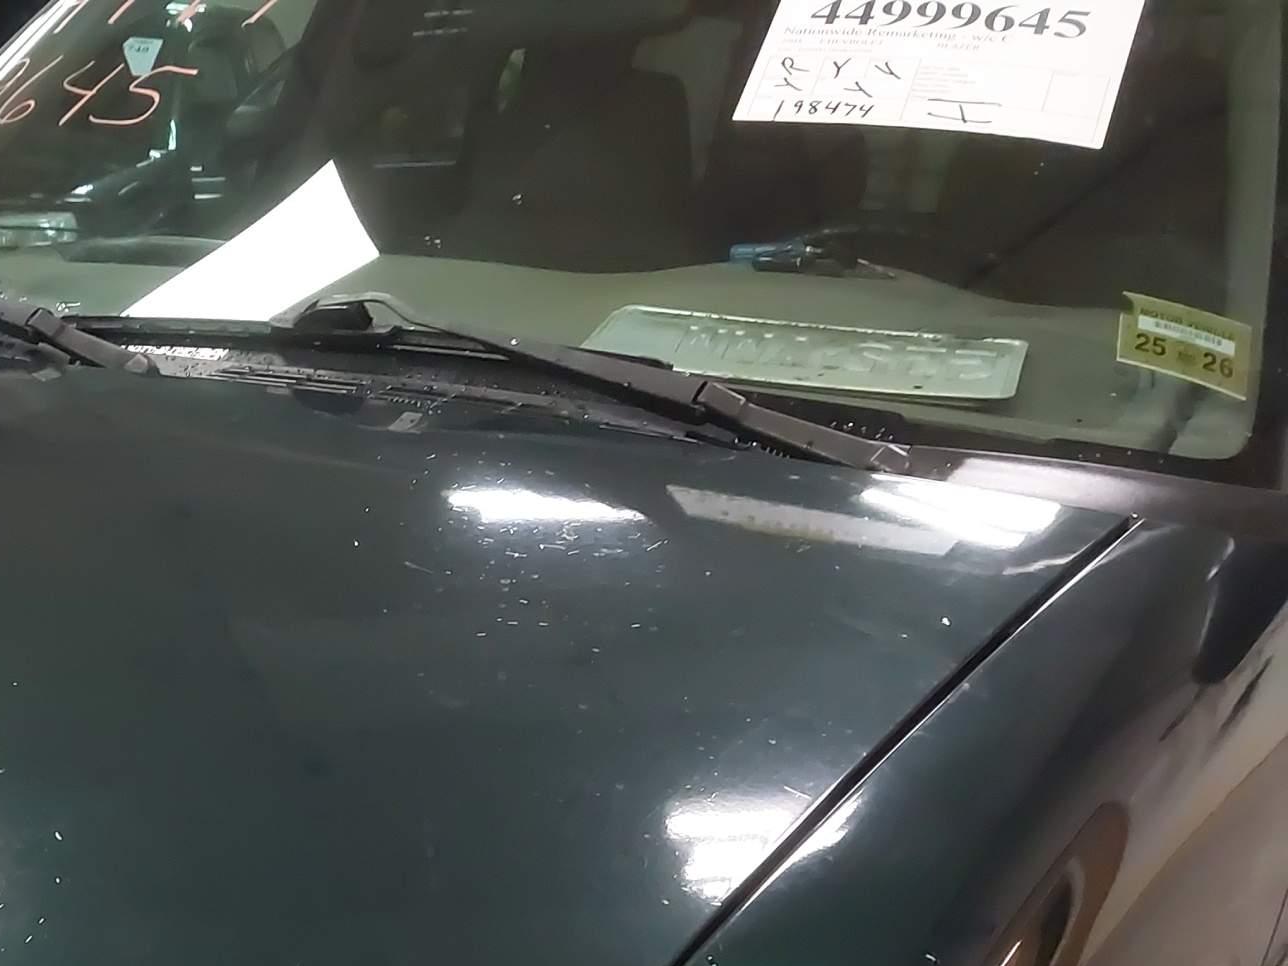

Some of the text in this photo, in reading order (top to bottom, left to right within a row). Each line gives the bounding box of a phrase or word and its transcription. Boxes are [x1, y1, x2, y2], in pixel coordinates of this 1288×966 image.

[784, 27, 862, 36] Nationwide
[867, 28, 957, 41] Remarketing
[810, 0, 1091, 39] 44999645
[773, 100, 874, 121] 198474
[1134, 333, 1167, 356] 25
[1202, 351, 1234, 378] 26
